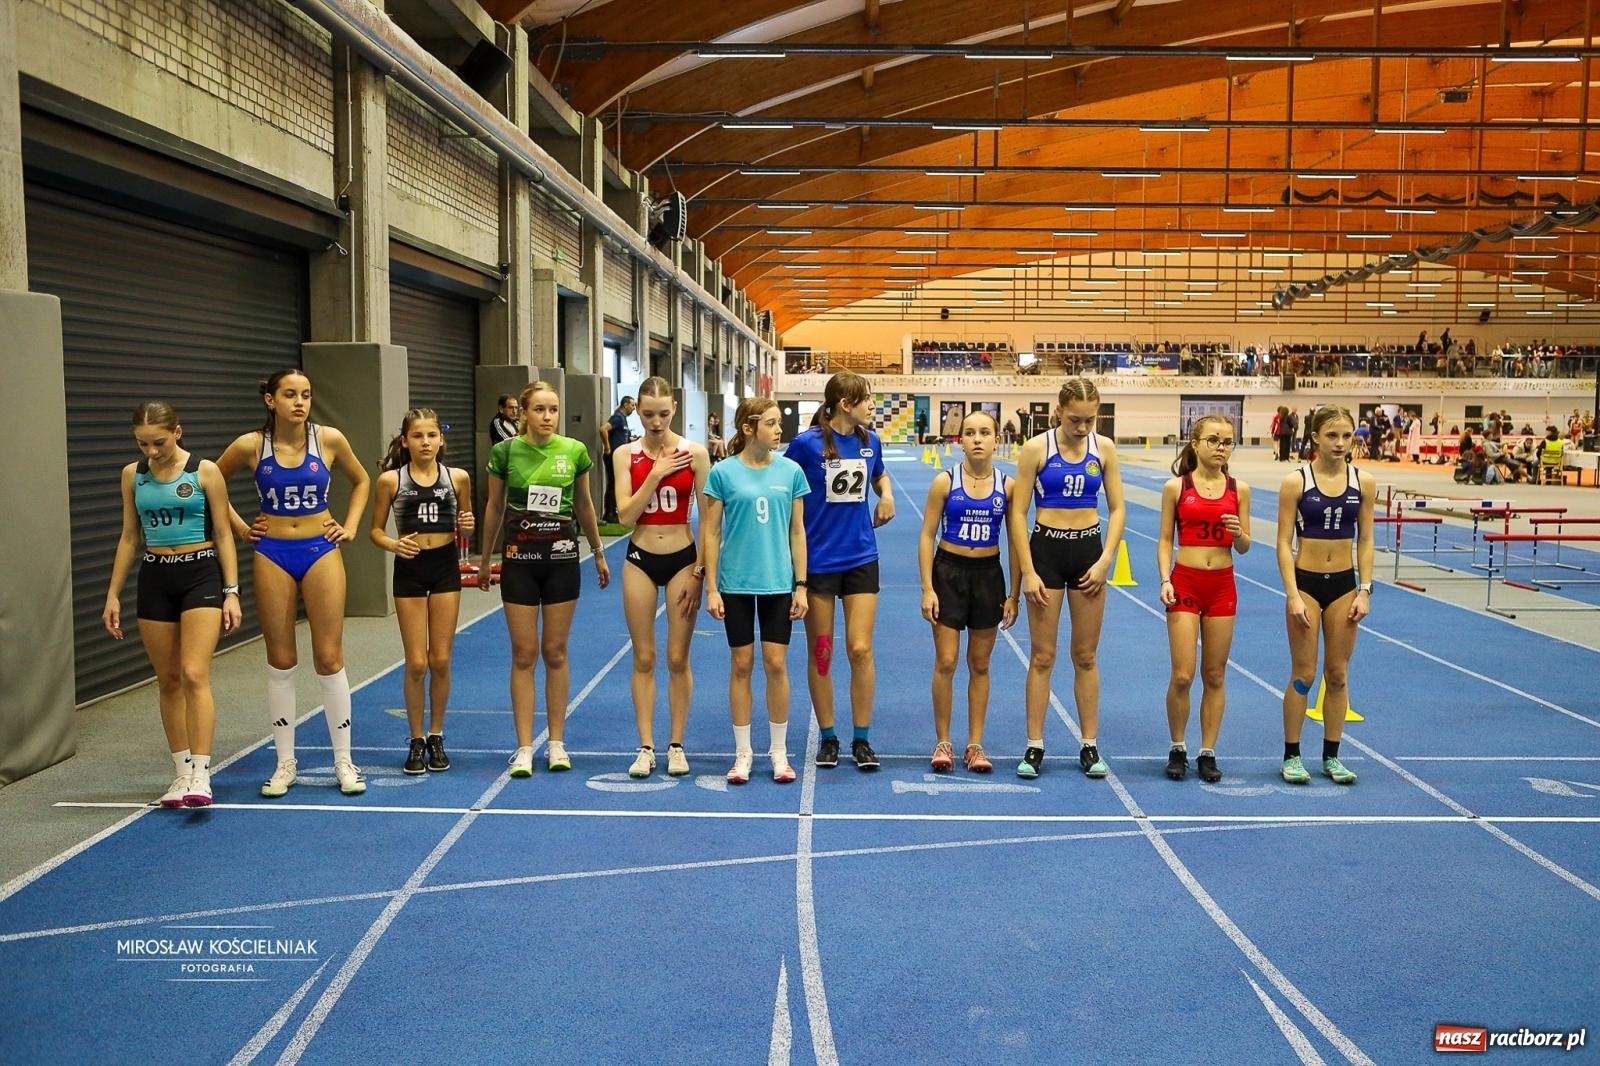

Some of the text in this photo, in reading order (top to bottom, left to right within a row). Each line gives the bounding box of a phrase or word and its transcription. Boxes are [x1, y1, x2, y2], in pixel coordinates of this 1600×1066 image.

[831, 470, 864, 495] 62
[1062, 474, 1085, 497] 30
[266, 485, 318, 511] 155
[529, 492, 558, 507] 726
[145, 507, 185, 528] 307
[417, 502, 439, 523] 40
[755, 496, 769, 524] 9
[1323, 506, 1343, 530] 11
[1045, 525, 1102, 540] NIKE PRO
[1196, 520, 1226, 541] 36
[159, 552, 195, 564] NIKE
